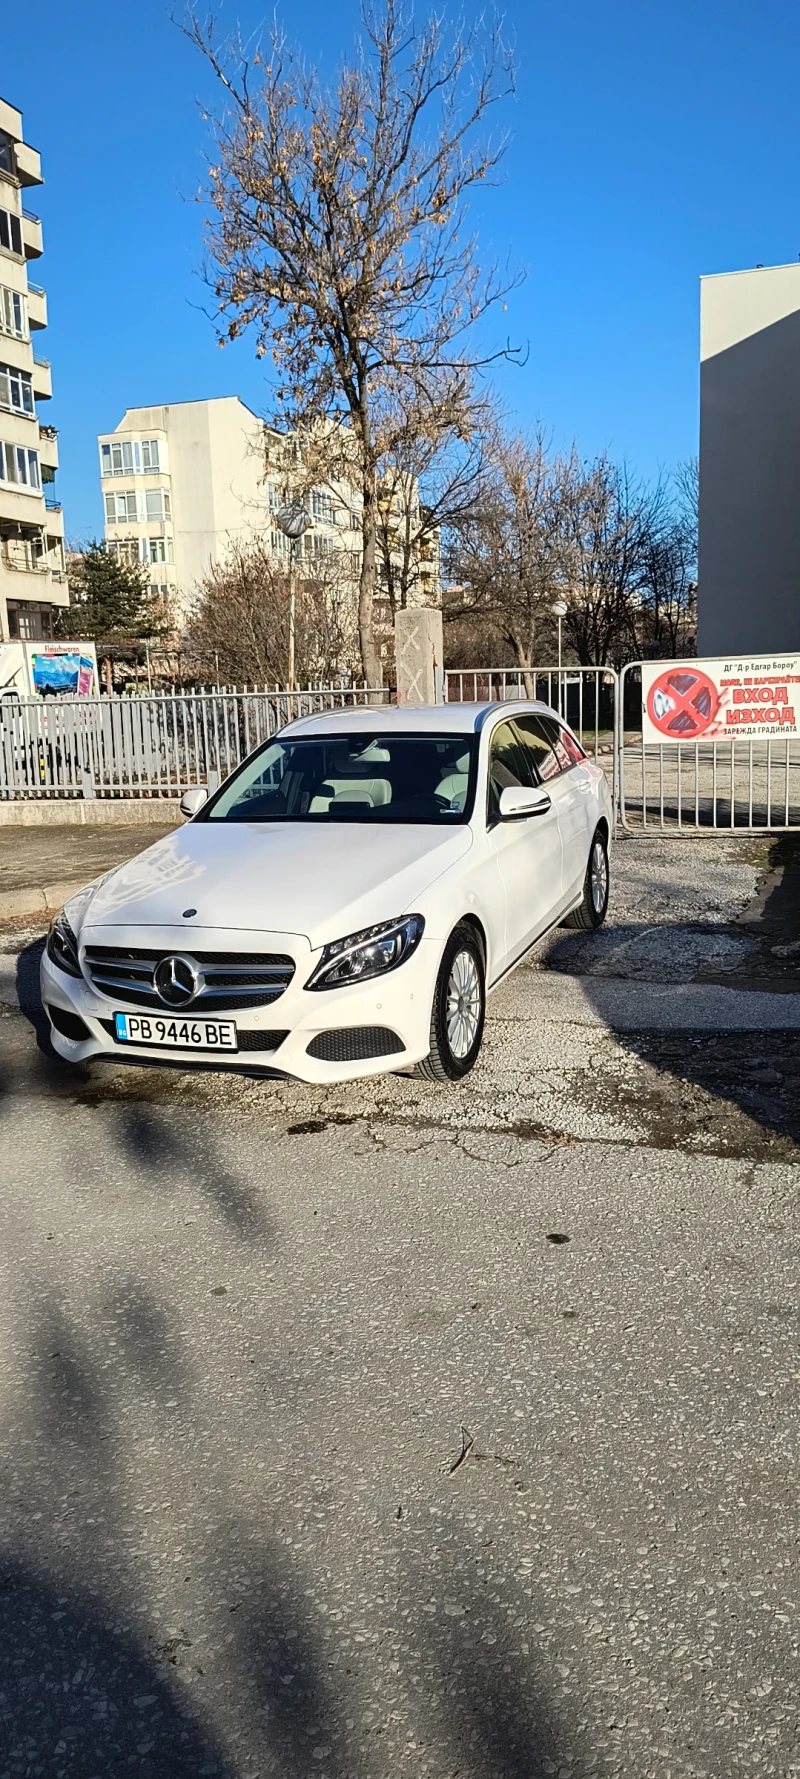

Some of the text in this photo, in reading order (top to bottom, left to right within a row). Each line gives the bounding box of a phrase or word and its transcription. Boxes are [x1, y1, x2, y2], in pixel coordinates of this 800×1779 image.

[751, 663, 771, 671] Едгар
[733, 687, 788, 705] ВХОД
[726, 707, 795, 725] ИЗХОД
[724, 726, 797, 735] ЗАРЕЖДА ГРАДИНАТА
[128, 1018, 232, 1045] PB 9446 BE
